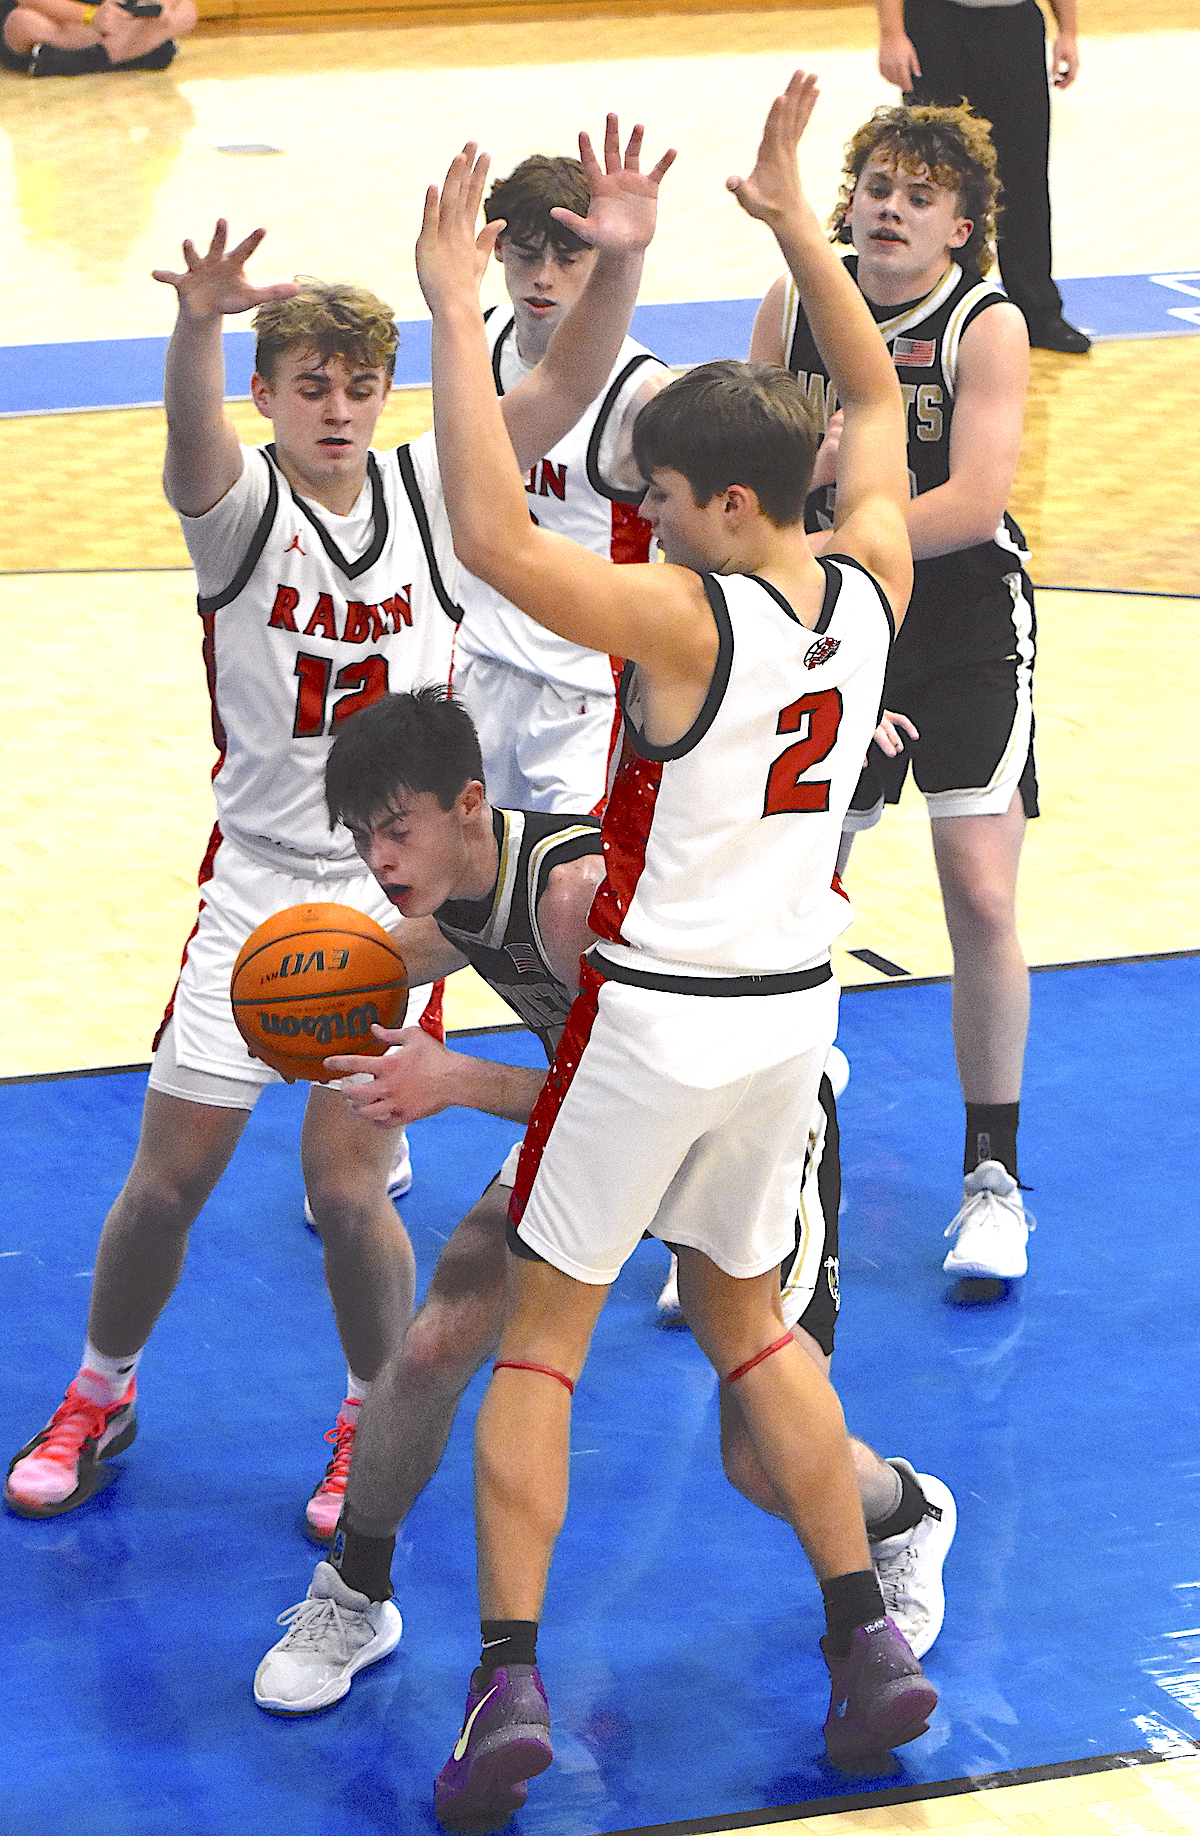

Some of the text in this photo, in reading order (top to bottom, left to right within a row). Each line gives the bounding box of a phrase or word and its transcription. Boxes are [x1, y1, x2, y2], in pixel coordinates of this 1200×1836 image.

[293, 651, 390, 738] 12
[760, 686, 844, 820] 2
[279, 948, 350, 978] EVO
[260, 1003, 379, 1044] Wilson
